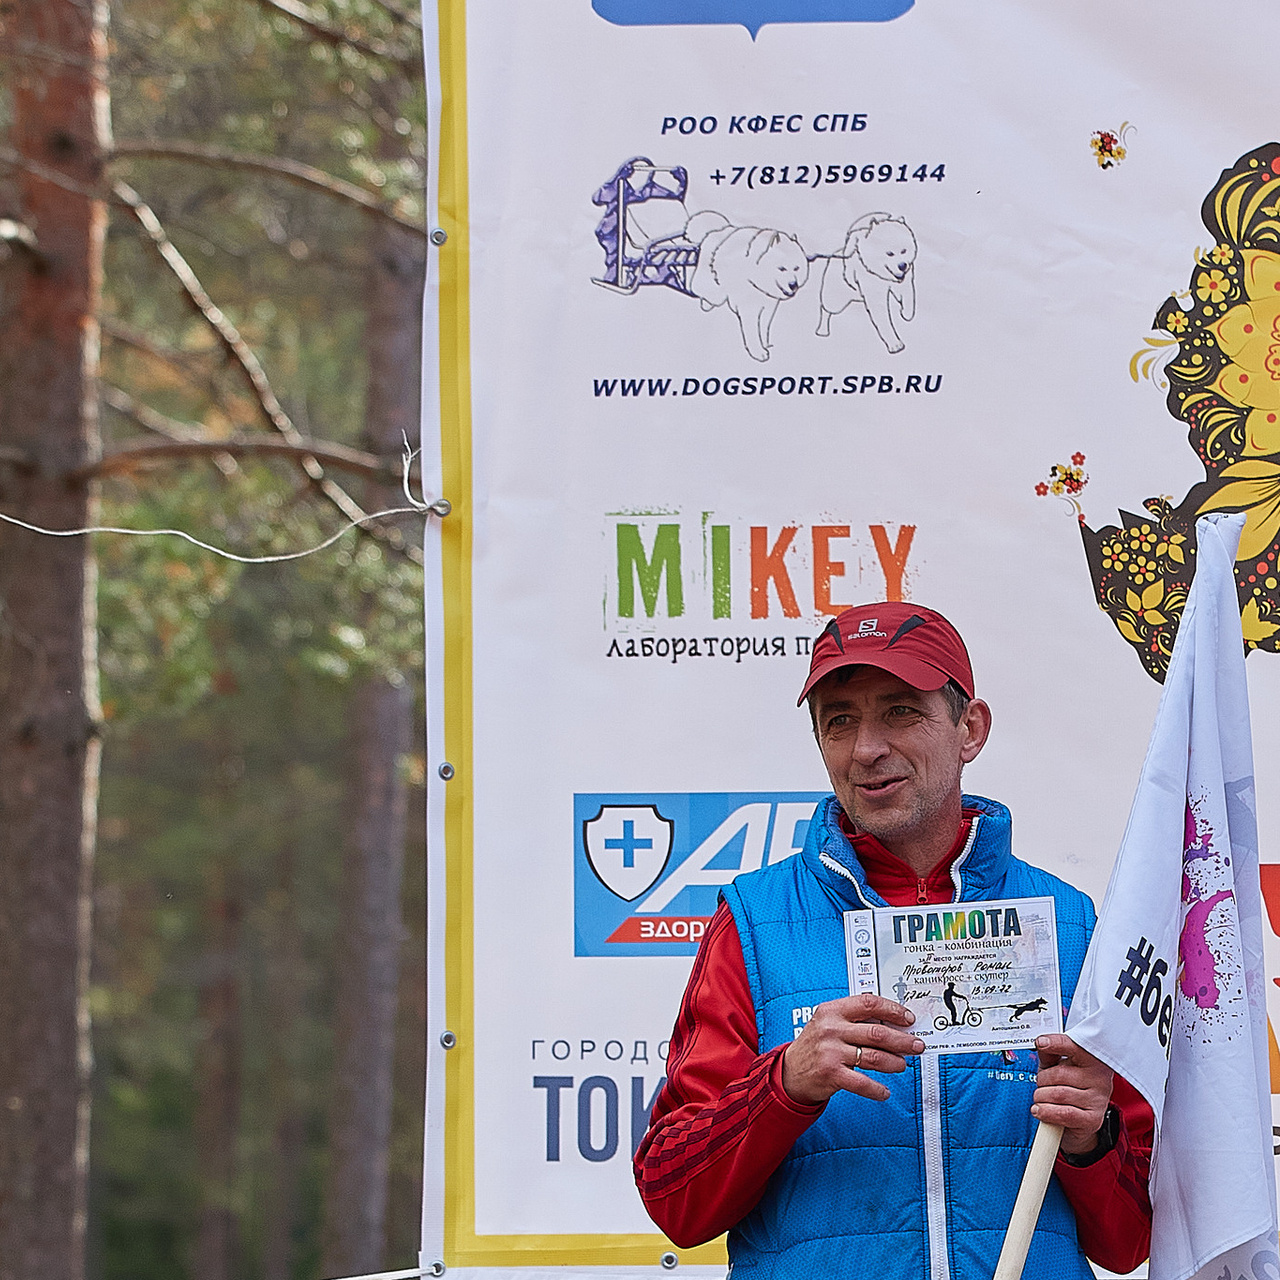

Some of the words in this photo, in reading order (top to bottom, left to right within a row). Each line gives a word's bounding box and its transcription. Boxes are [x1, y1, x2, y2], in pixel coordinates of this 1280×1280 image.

[661, 116, 718, 135] РОО
[728, 114, 802, 134] КФЕС
[812, 113, 868, 132] СПБ
[709, 164, 947, 189] +7(812)5969144
[592, 374, 943, 397] WWW.DOGSPORT.SPB.RU
[616, 523, 918, 620] MIKEY
[606, 636, 786, 664] лаборатория
[796, 636, 817, 656] п
[893, 908, 1022, 944] ГРАМОТА
[904, 944, 935, 953] гонка
[944, 938, 1013, 951] комбинация
[913, 975, 964, 986] каникросс
[974, 972, 1009, 983] скутер
